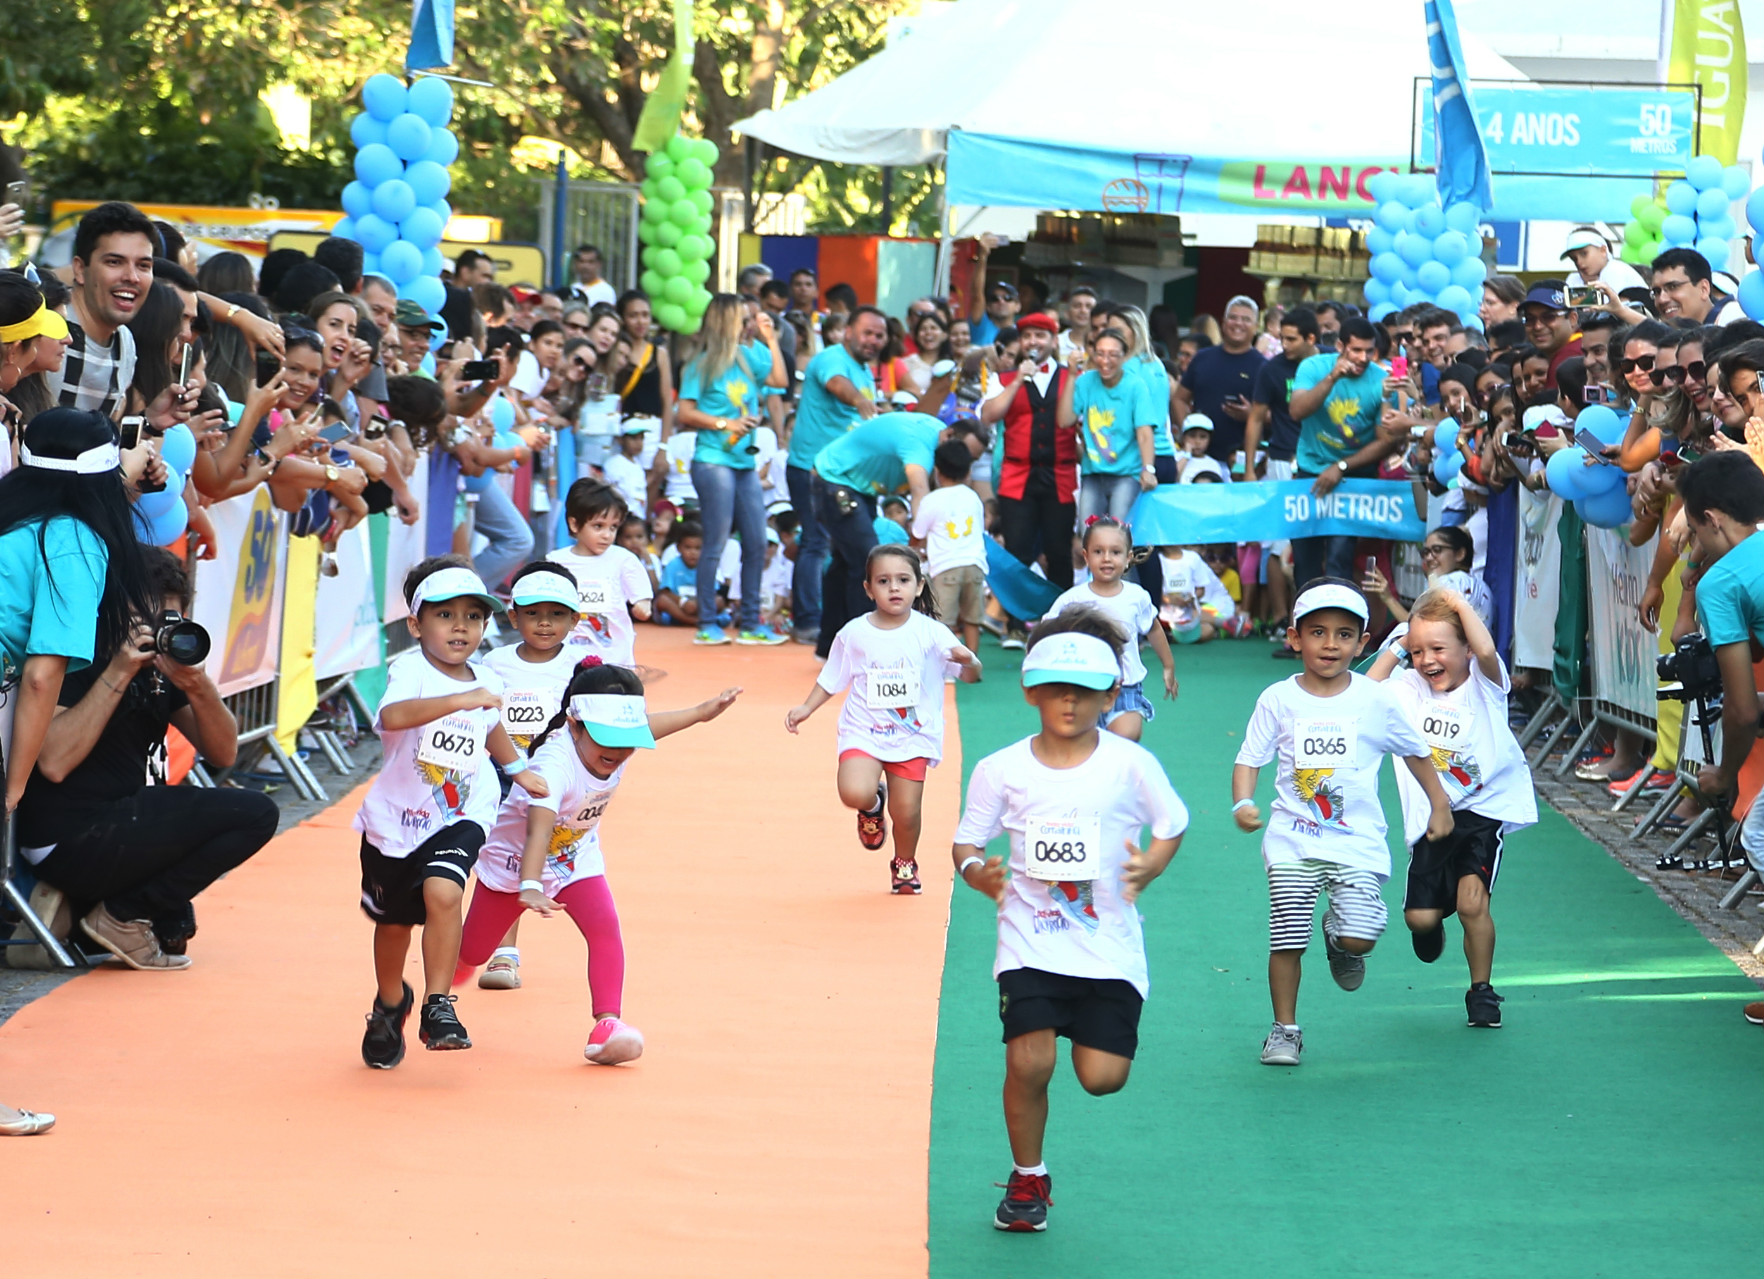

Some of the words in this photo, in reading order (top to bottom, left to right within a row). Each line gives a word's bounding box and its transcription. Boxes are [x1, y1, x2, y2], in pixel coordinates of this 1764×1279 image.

[1692, 0, 1735, 129] IGUA
[1486, 112, 1503, 143] 4
[1510, 112, 1580, 146] ANOS
[1639, 104, 1671, 136] 50
[1630, 138, 1677, 154] METROS
[1254, 164, 1398, 202] LANC
[1284, 494, 1309, 522] 50
[1315, 493, 1404, 522] METROS
[876, 683, 907, 697] 1084
[507, 706, 545, 722] 0223
[1423, 717, 1460, 739] 0019
[431, 730, 475, 757] 0673
[1304, 738, 1347, 755] 0365
[1035, 840, 1087, 863] 0683
